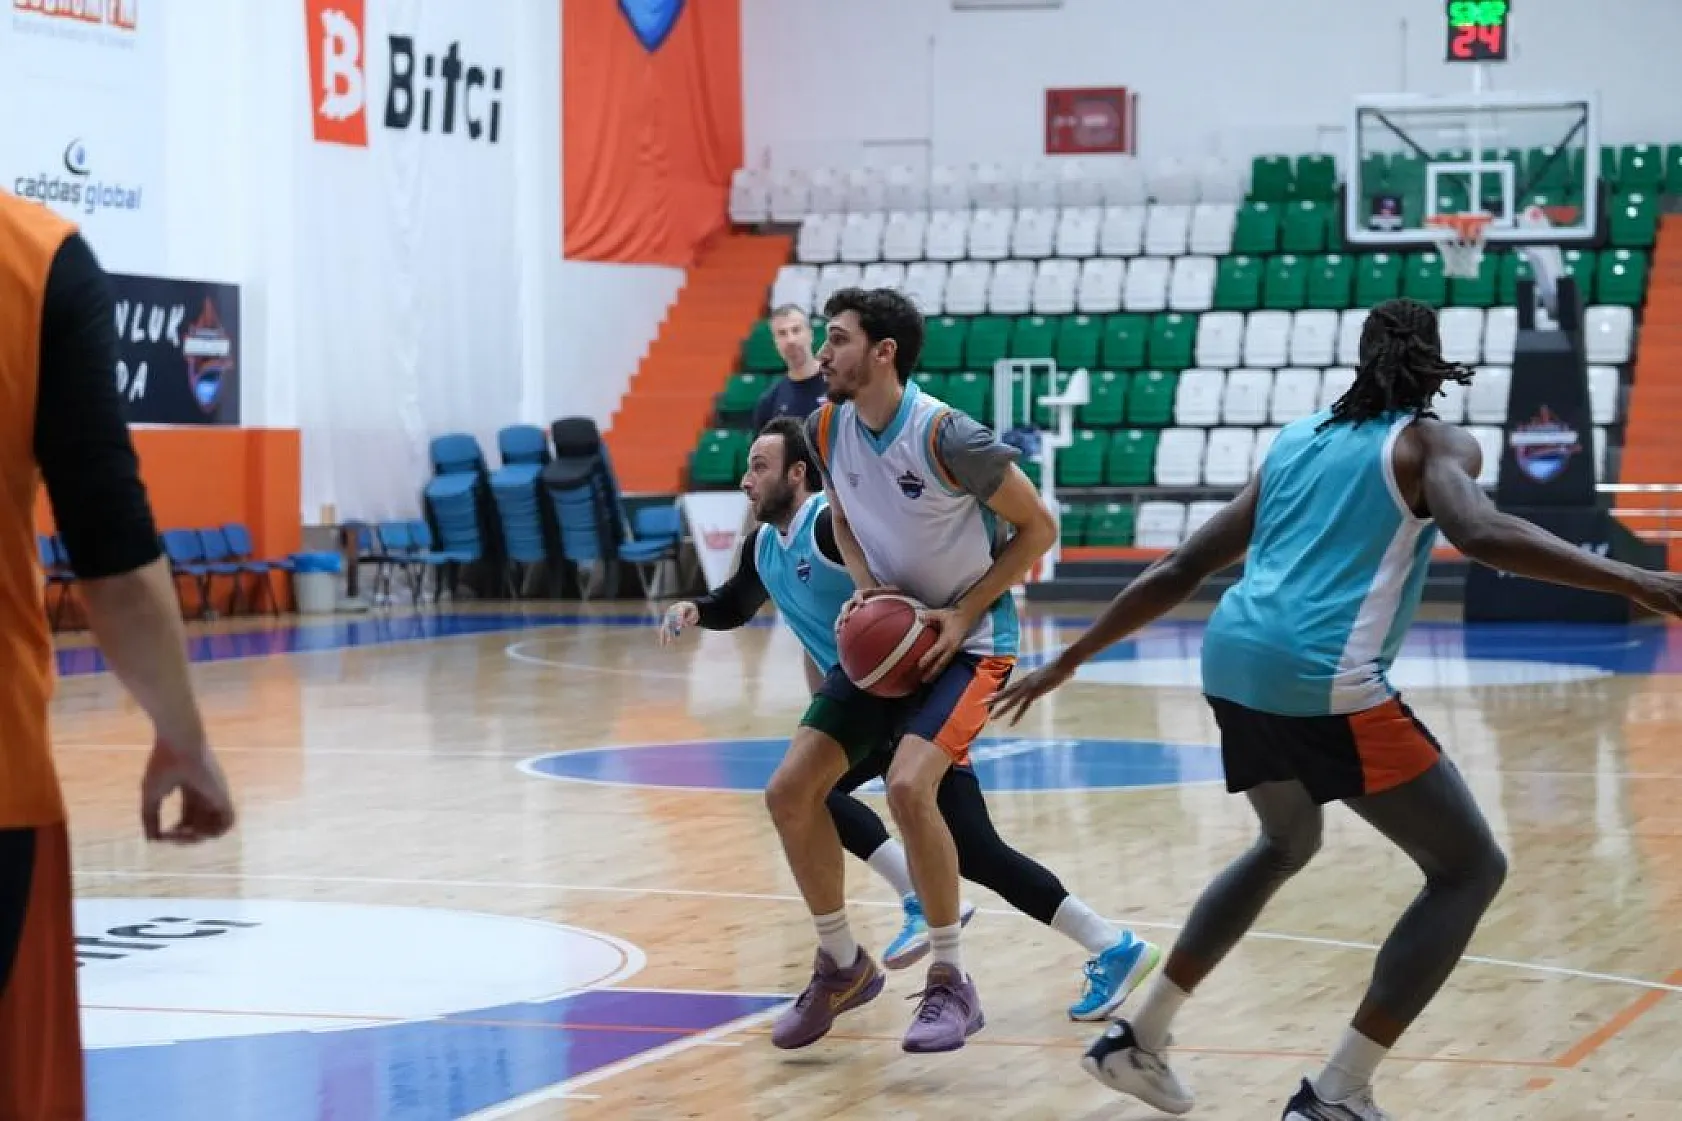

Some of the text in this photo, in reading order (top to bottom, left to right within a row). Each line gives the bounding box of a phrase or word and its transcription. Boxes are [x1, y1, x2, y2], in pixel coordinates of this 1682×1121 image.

[1451, 25, 1502, 58] 24
[383, 33, 503, 143] Bitci
[84, 181, 143, 215] global
